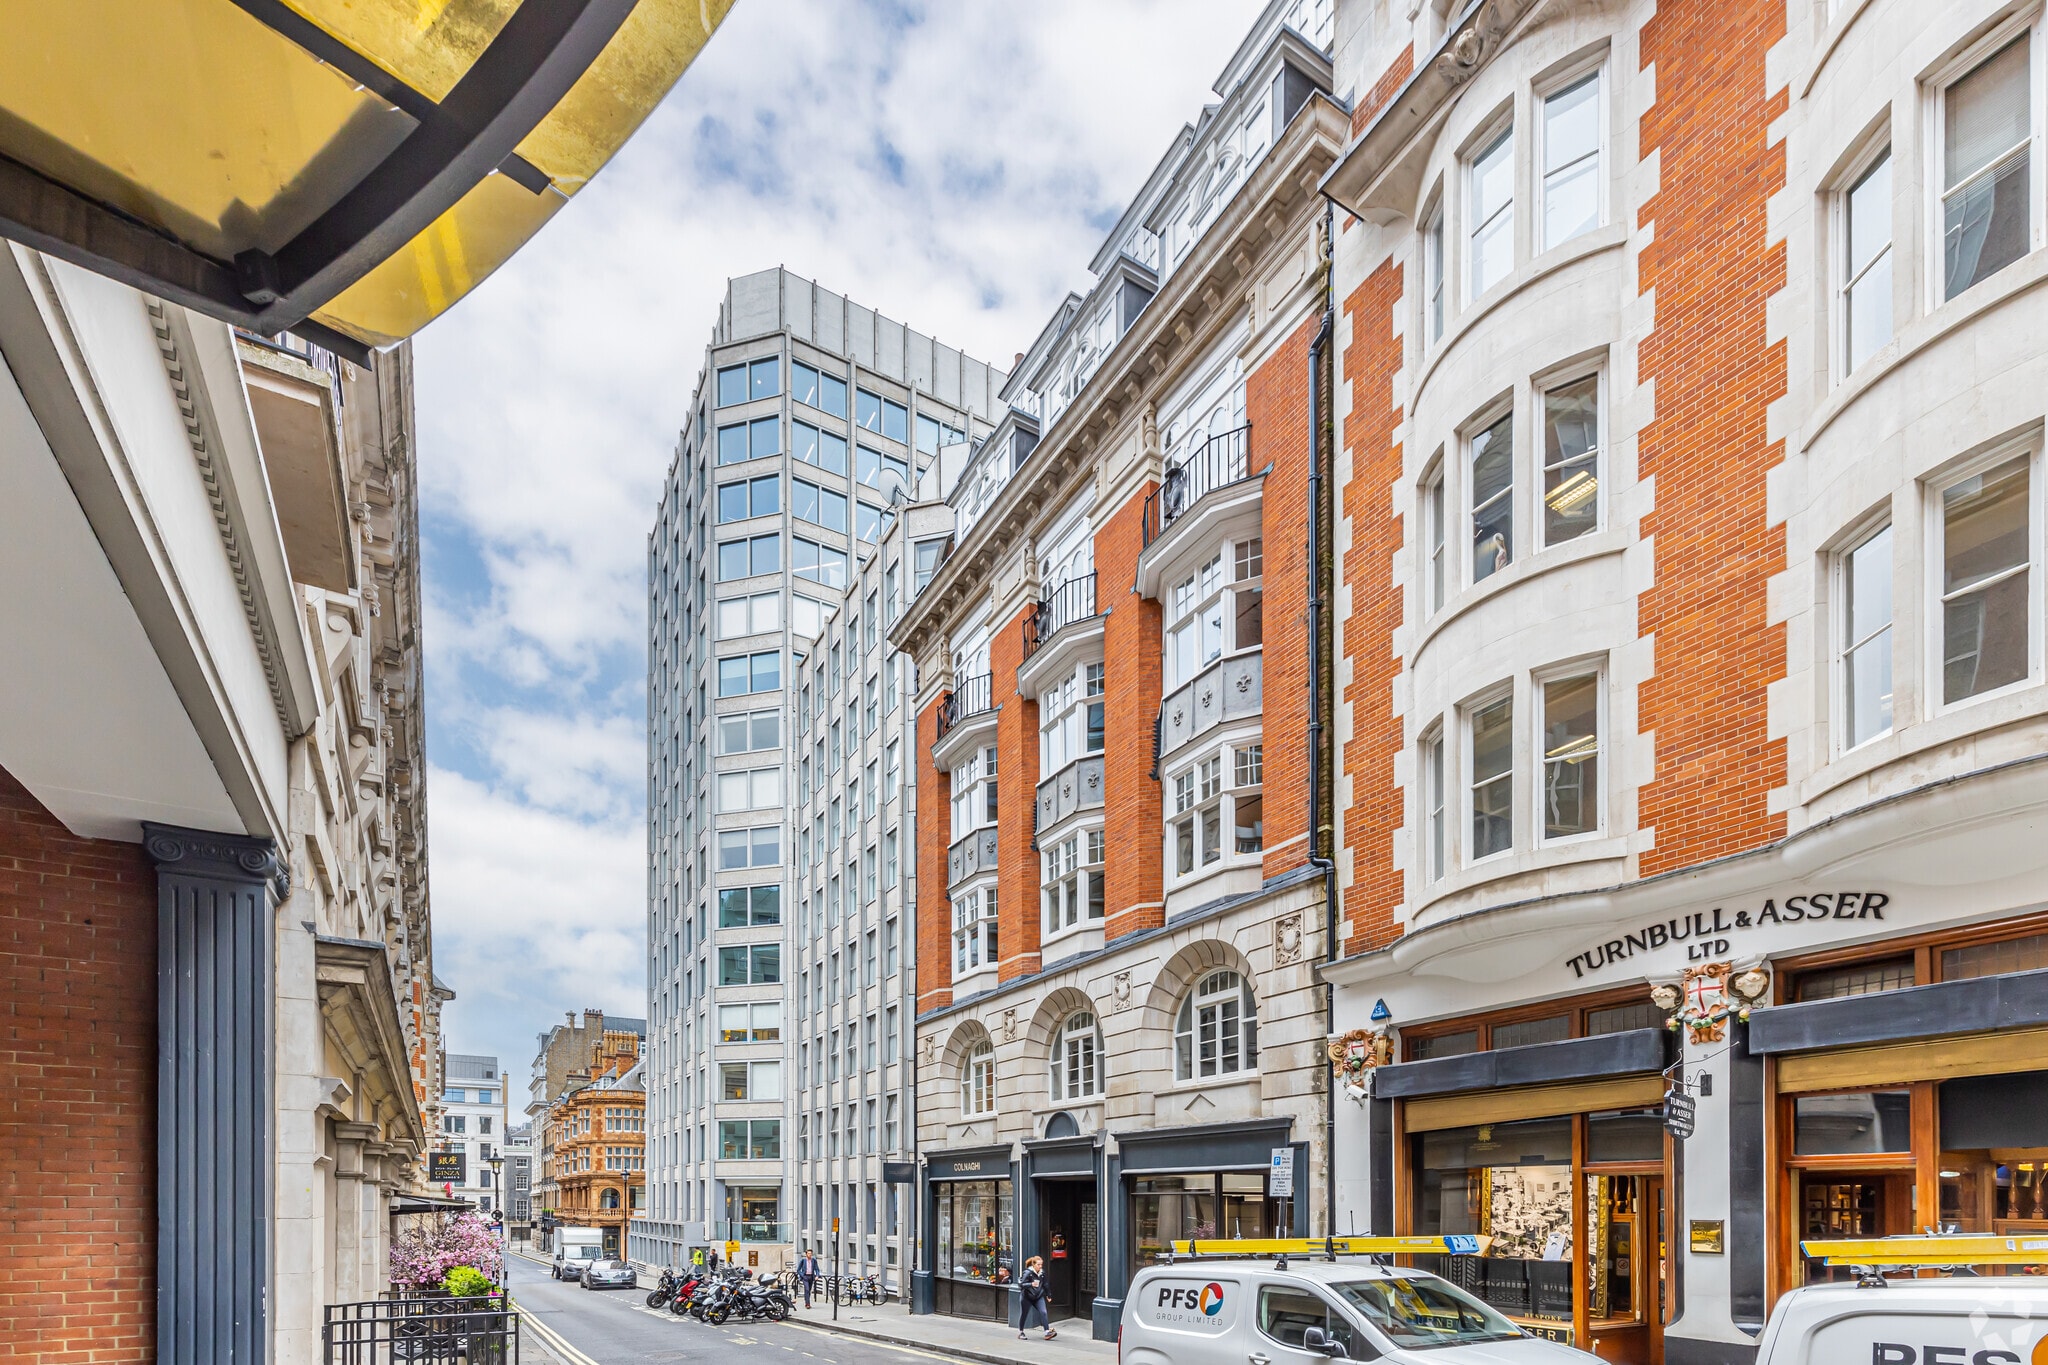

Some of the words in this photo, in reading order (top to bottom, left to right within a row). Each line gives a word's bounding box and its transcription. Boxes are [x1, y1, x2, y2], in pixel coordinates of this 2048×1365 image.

[1565, 907, 1732, 978] TURNBULL
[1734, 909, 1753, 928] &
[1756, 892, 1890, 926] ASSER
[1687, 938, 1731, 961] LTD
[1670, 1097, 1694, 1110] TURNBULL
[1676, 1109, 1691, 1119] ASSER
[438, 1155, 457, 1165] 銀座
[953, 1162, 981, 1171] COLNAGHI
[1158, 1288, 1199, 1310] PFS
[1156, 1313, 1183, 1321] GROUP
[1187, 1316, 1223, 1326] LIMITED
[1524, 1312, 1562, 1321] BESPOKE
[1526, 1327, 1557, 1341] SER
